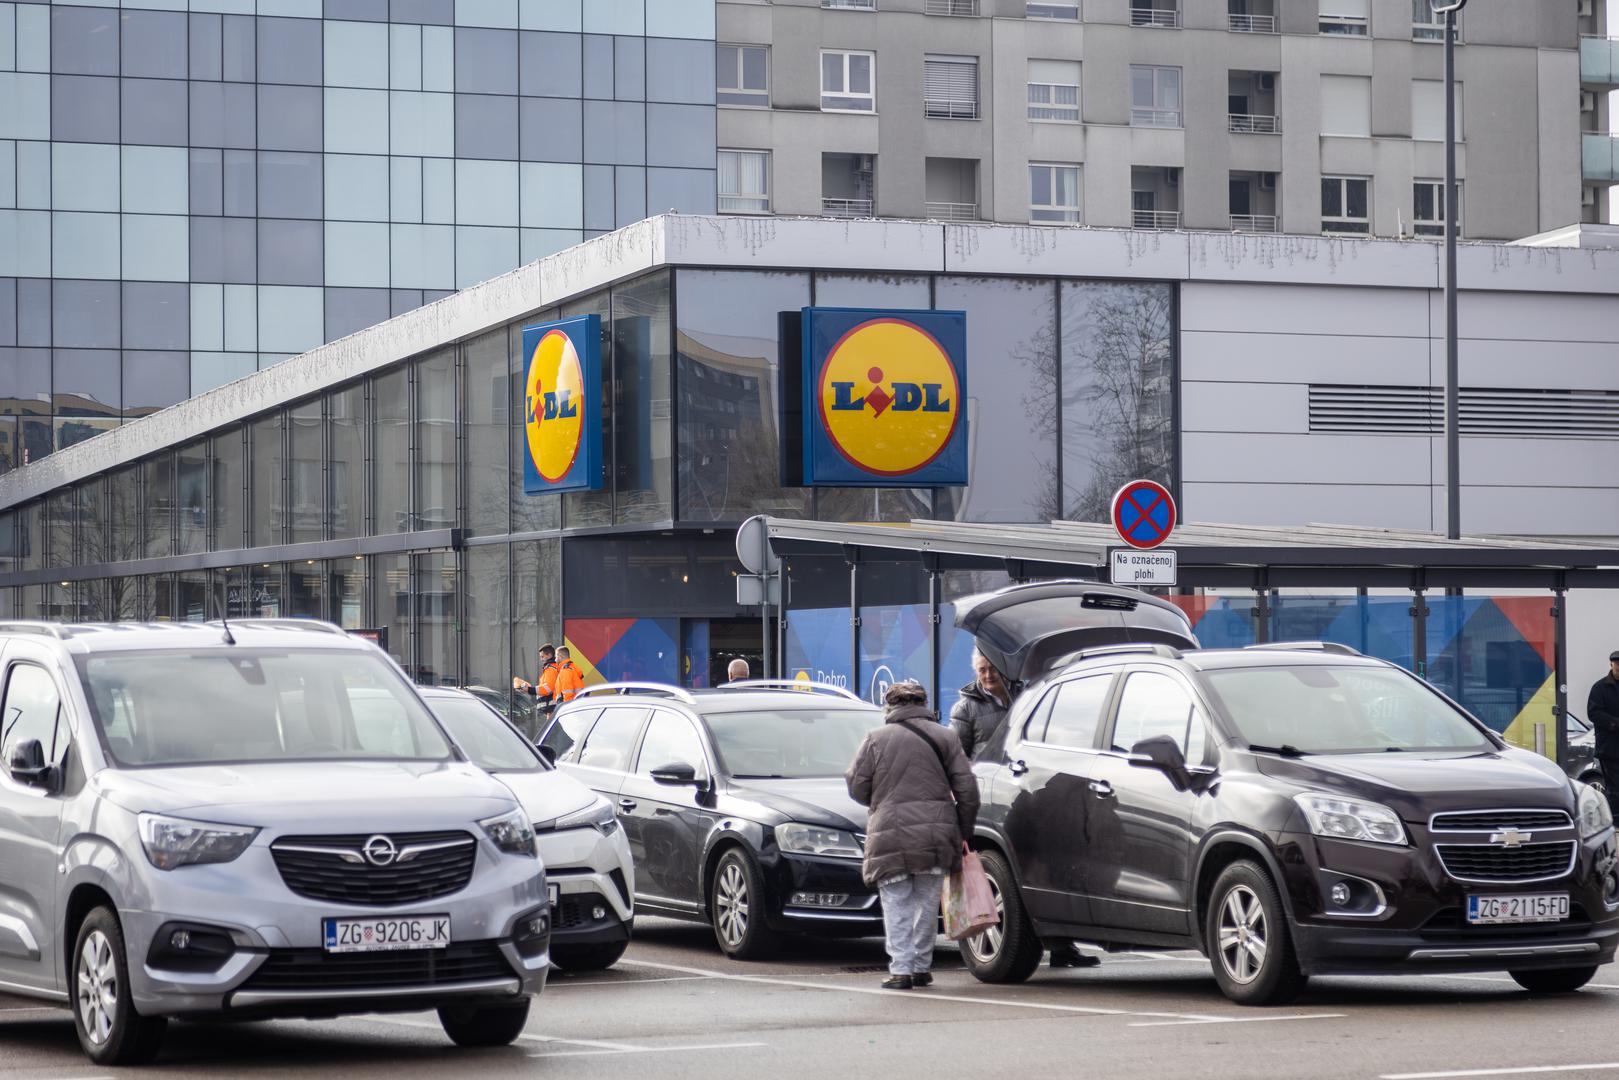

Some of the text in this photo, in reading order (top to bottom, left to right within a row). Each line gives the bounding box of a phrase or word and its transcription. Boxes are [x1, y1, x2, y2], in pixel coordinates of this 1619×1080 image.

[1117, 553, 1172, 568] Na označenoj
[1134, 568, 1154, 581] plohi
[1480, 898, 1500, 918] ZG
[340, 923, 362, 945] ZG
